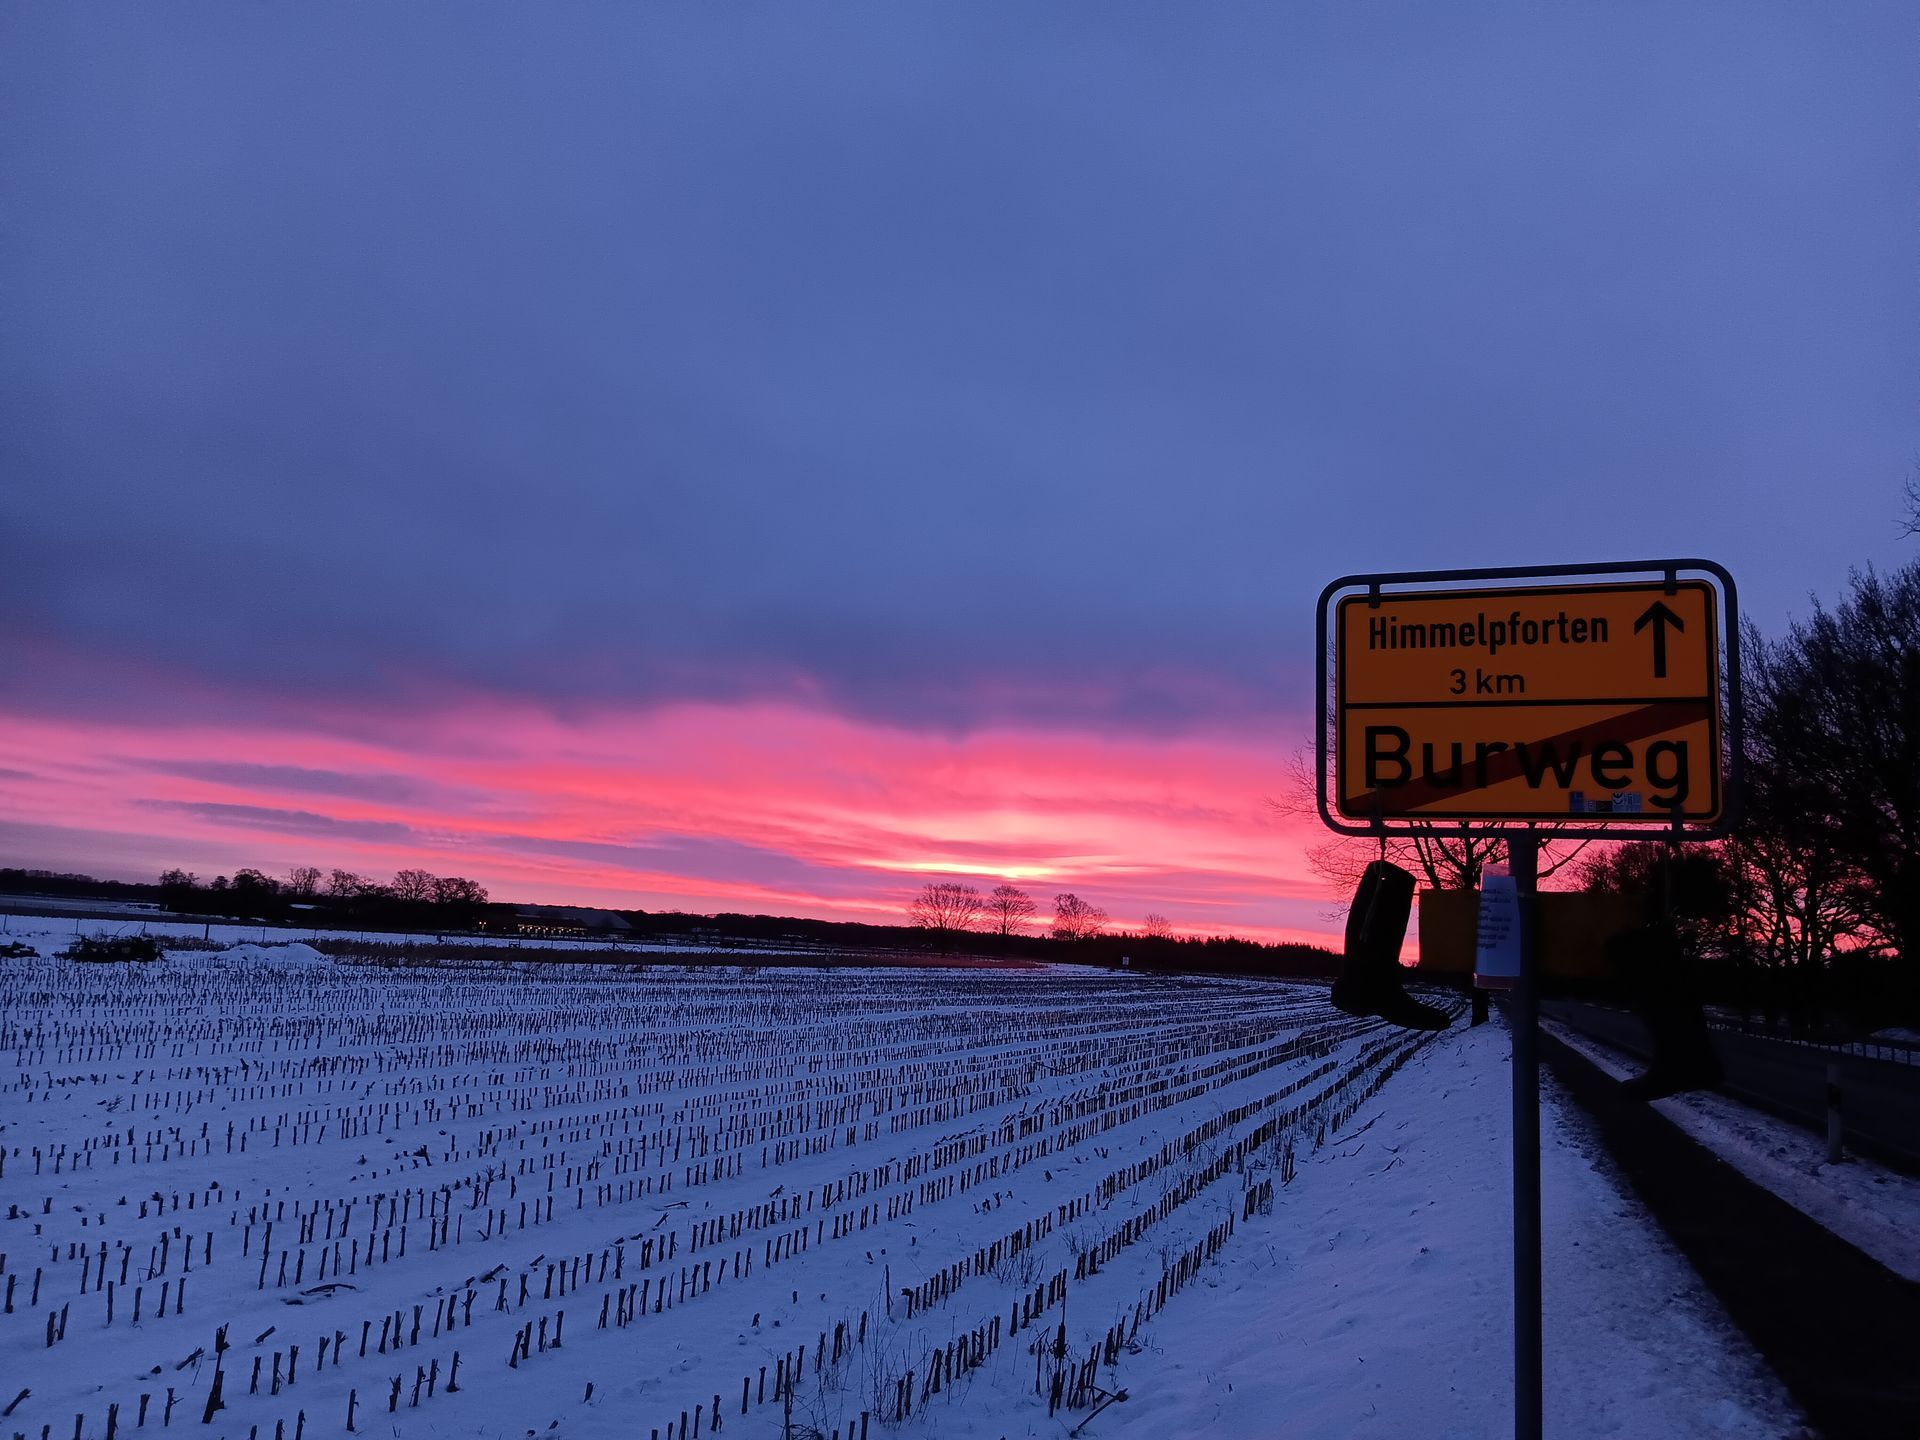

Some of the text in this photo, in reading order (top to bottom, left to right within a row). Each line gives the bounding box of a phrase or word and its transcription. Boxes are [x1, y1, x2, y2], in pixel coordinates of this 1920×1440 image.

[1369, 611, 1608, 655] Himmelpforten
[1450, 669, 1525, 695] 3 km
[1365, 725, 1690, 807] Burweg
